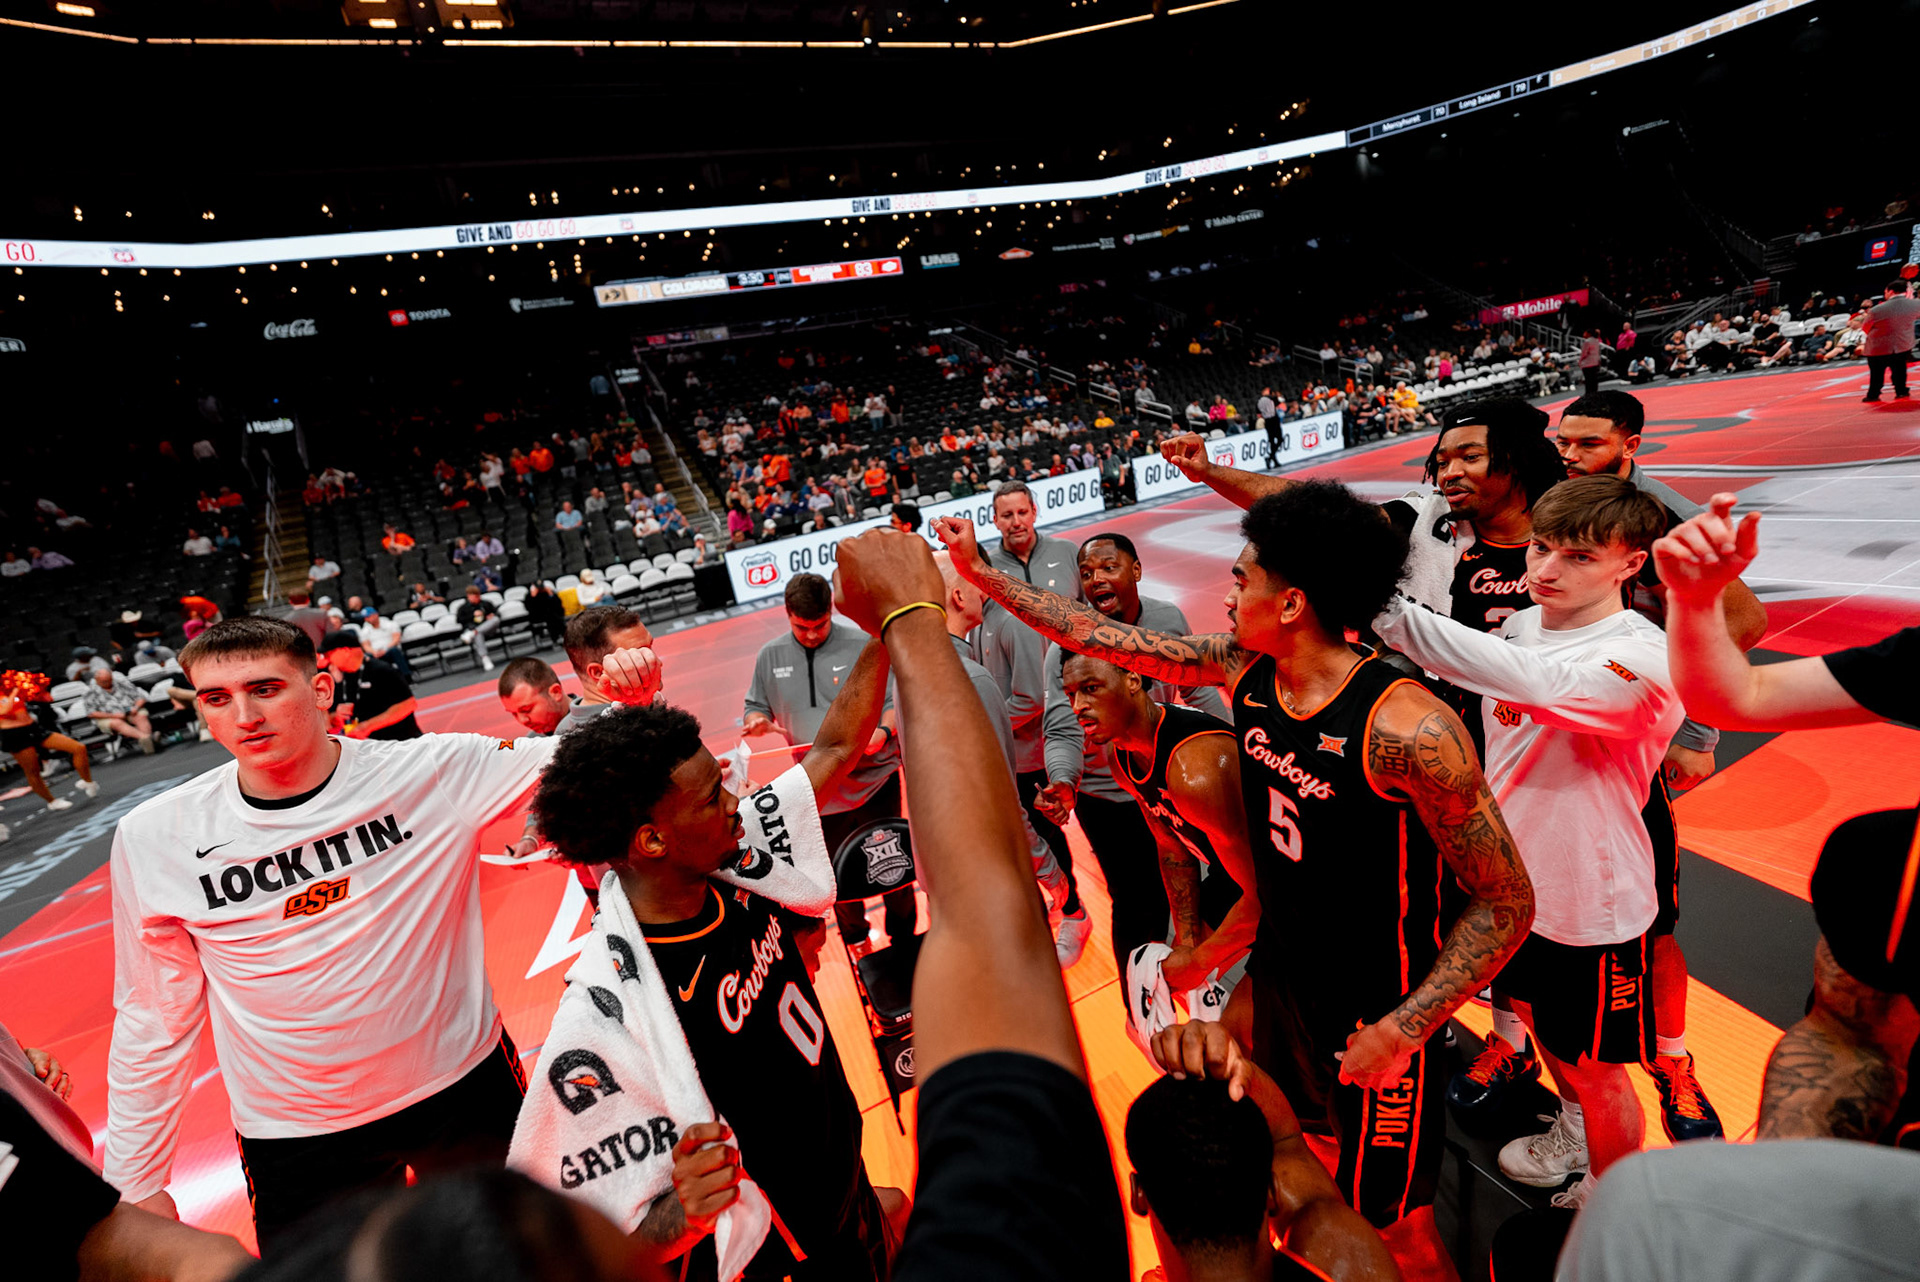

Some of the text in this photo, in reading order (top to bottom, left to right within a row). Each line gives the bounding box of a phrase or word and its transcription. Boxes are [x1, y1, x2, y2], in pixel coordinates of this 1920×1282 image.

[1382, 114, 1421, 132] Mercyhurst
[1458, 96, 1478, 110] Long
[1477, 90, 1501, 105] Island
[1145, 171, 1163, 184] GIVE
[1165, 166, 1182, 179] AND
[852, 199, 871, 213] GIVE
[874, 198, 891, 211] AND
[456, 226, 484, 243] GIVE
[488, 224, 512, 241] AND
[516, 222, 533, 238] GO
[538, 220, 555, 237] GO
[920, 253, 960, 267] UMB
[633, 284, 654, 299] 71
[662, 277, 727, 295] COLORADO
[408, 308, 452, 321] TOYOTA
[1517, 298, 1562, 317] Mobile
[1325, 421, 1338, 440] GO
[1242, 441, 1256, 461] GO
[1145, 464, 1161, 485] GO
[1047, 487, 1064, 509] GO
[1068, 481, 1086, 503] GO
[789, 547, 812, 572] GO
[750, 565, 774, 584] 66
[1244, 726, 1336, 800] Cowboys
[1267, 786, 1303, 862] 5
[199, 813, 413, 910] LOCK IT IN.
[864, 837, 902, 867] XII
[283, 876, 351, 920] OSU
[717, 914, 783, 1034] Cowboys
[778, 981, 824, 1067] 0
[561, 1116, 679, 1190] GATOR
